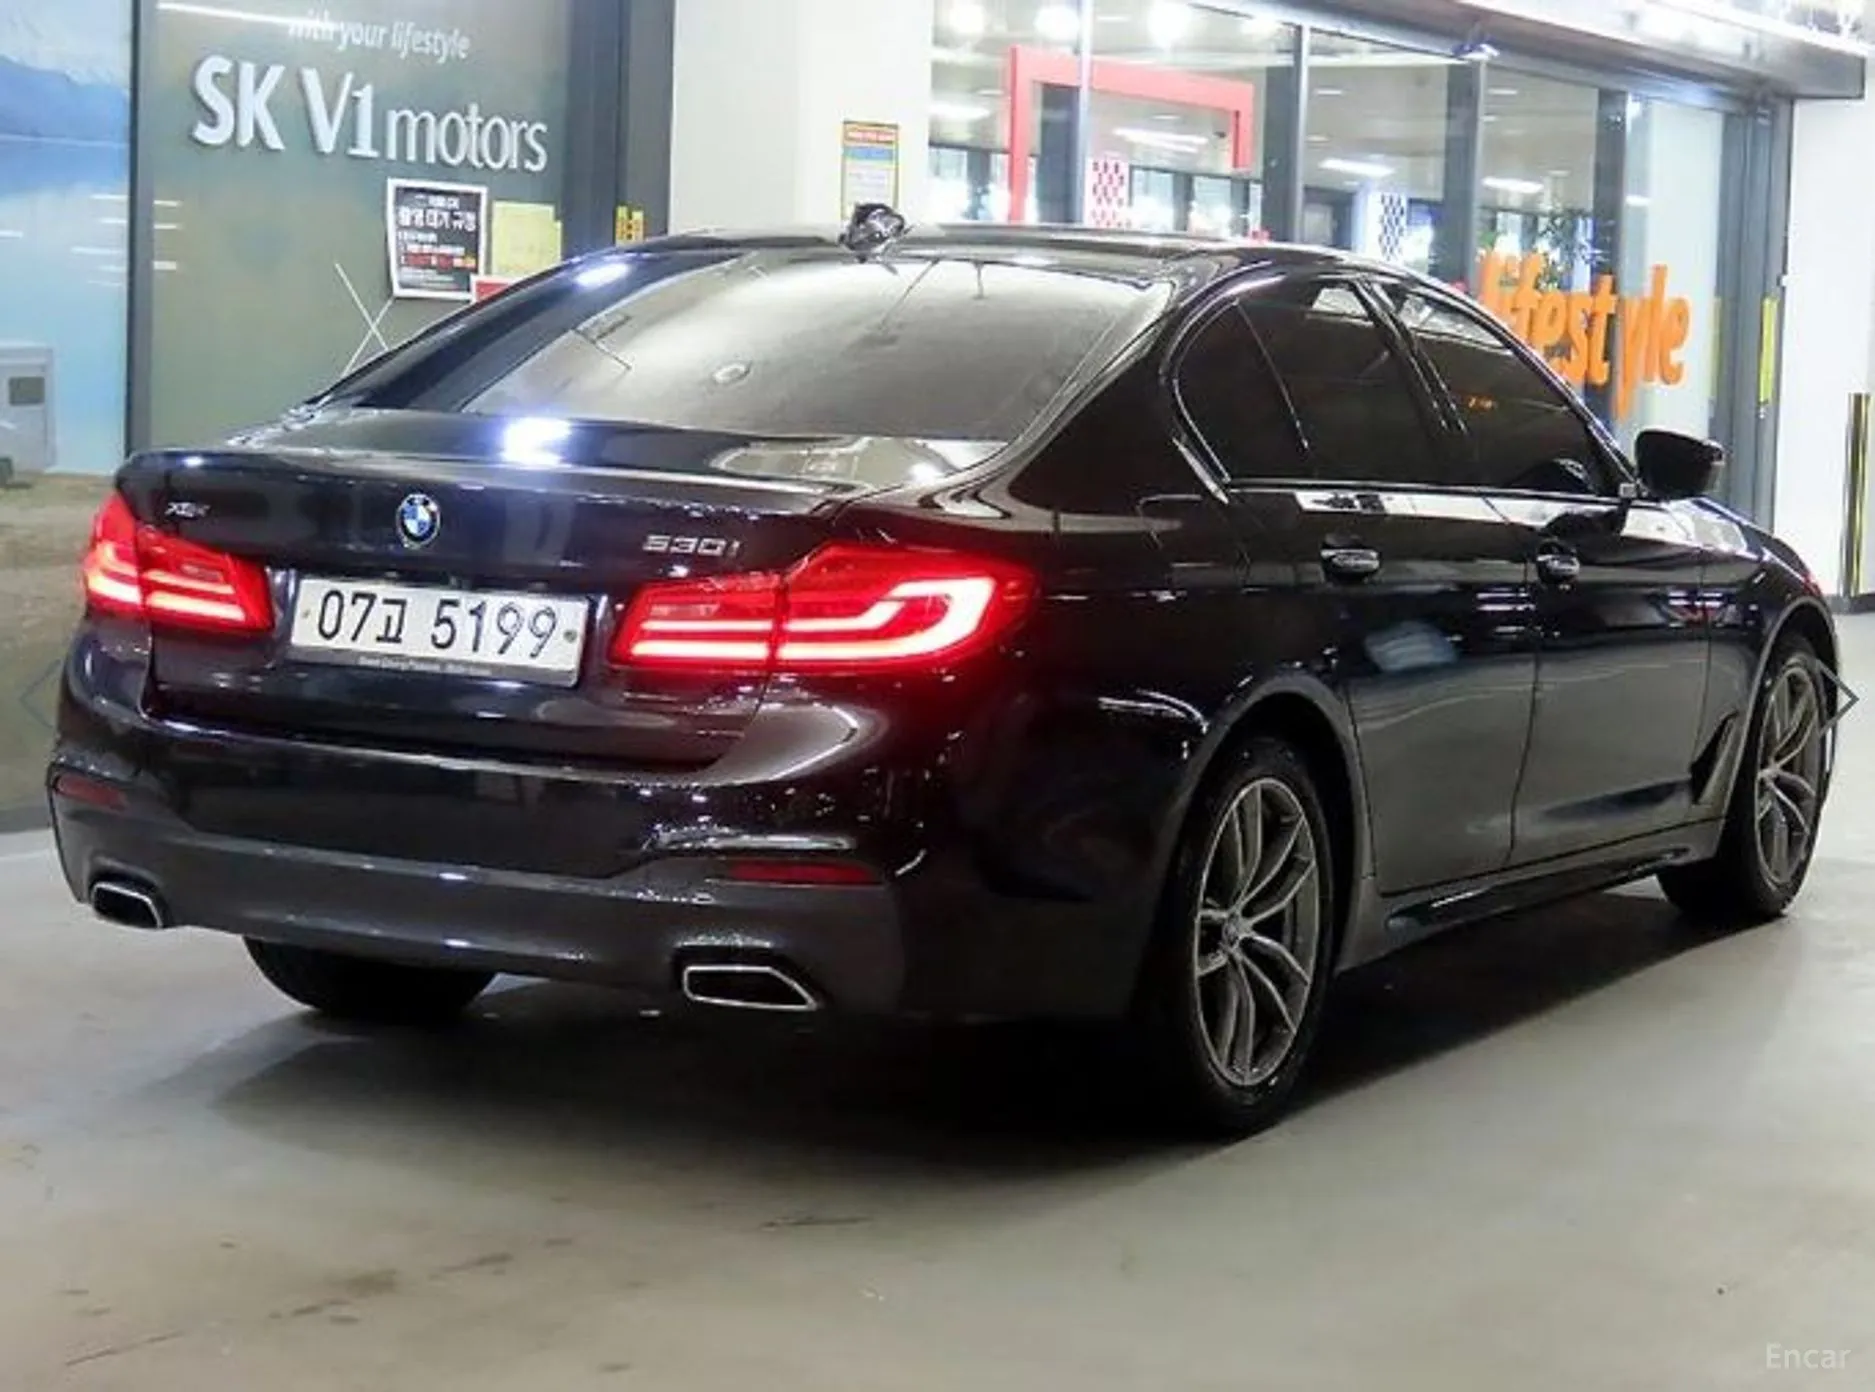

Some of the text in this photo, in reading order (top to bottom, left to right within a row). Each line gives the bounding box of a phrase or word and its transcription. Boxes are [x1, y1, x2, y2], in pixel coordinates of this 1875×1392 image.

[336, 21, 388, 51] your
[391, 21, 471, 64] lifestyle
[192, 55, 286, 151] SK
[642, 534, 740, 556] 530i
[318, 589, 557, 658] 07고 5199
